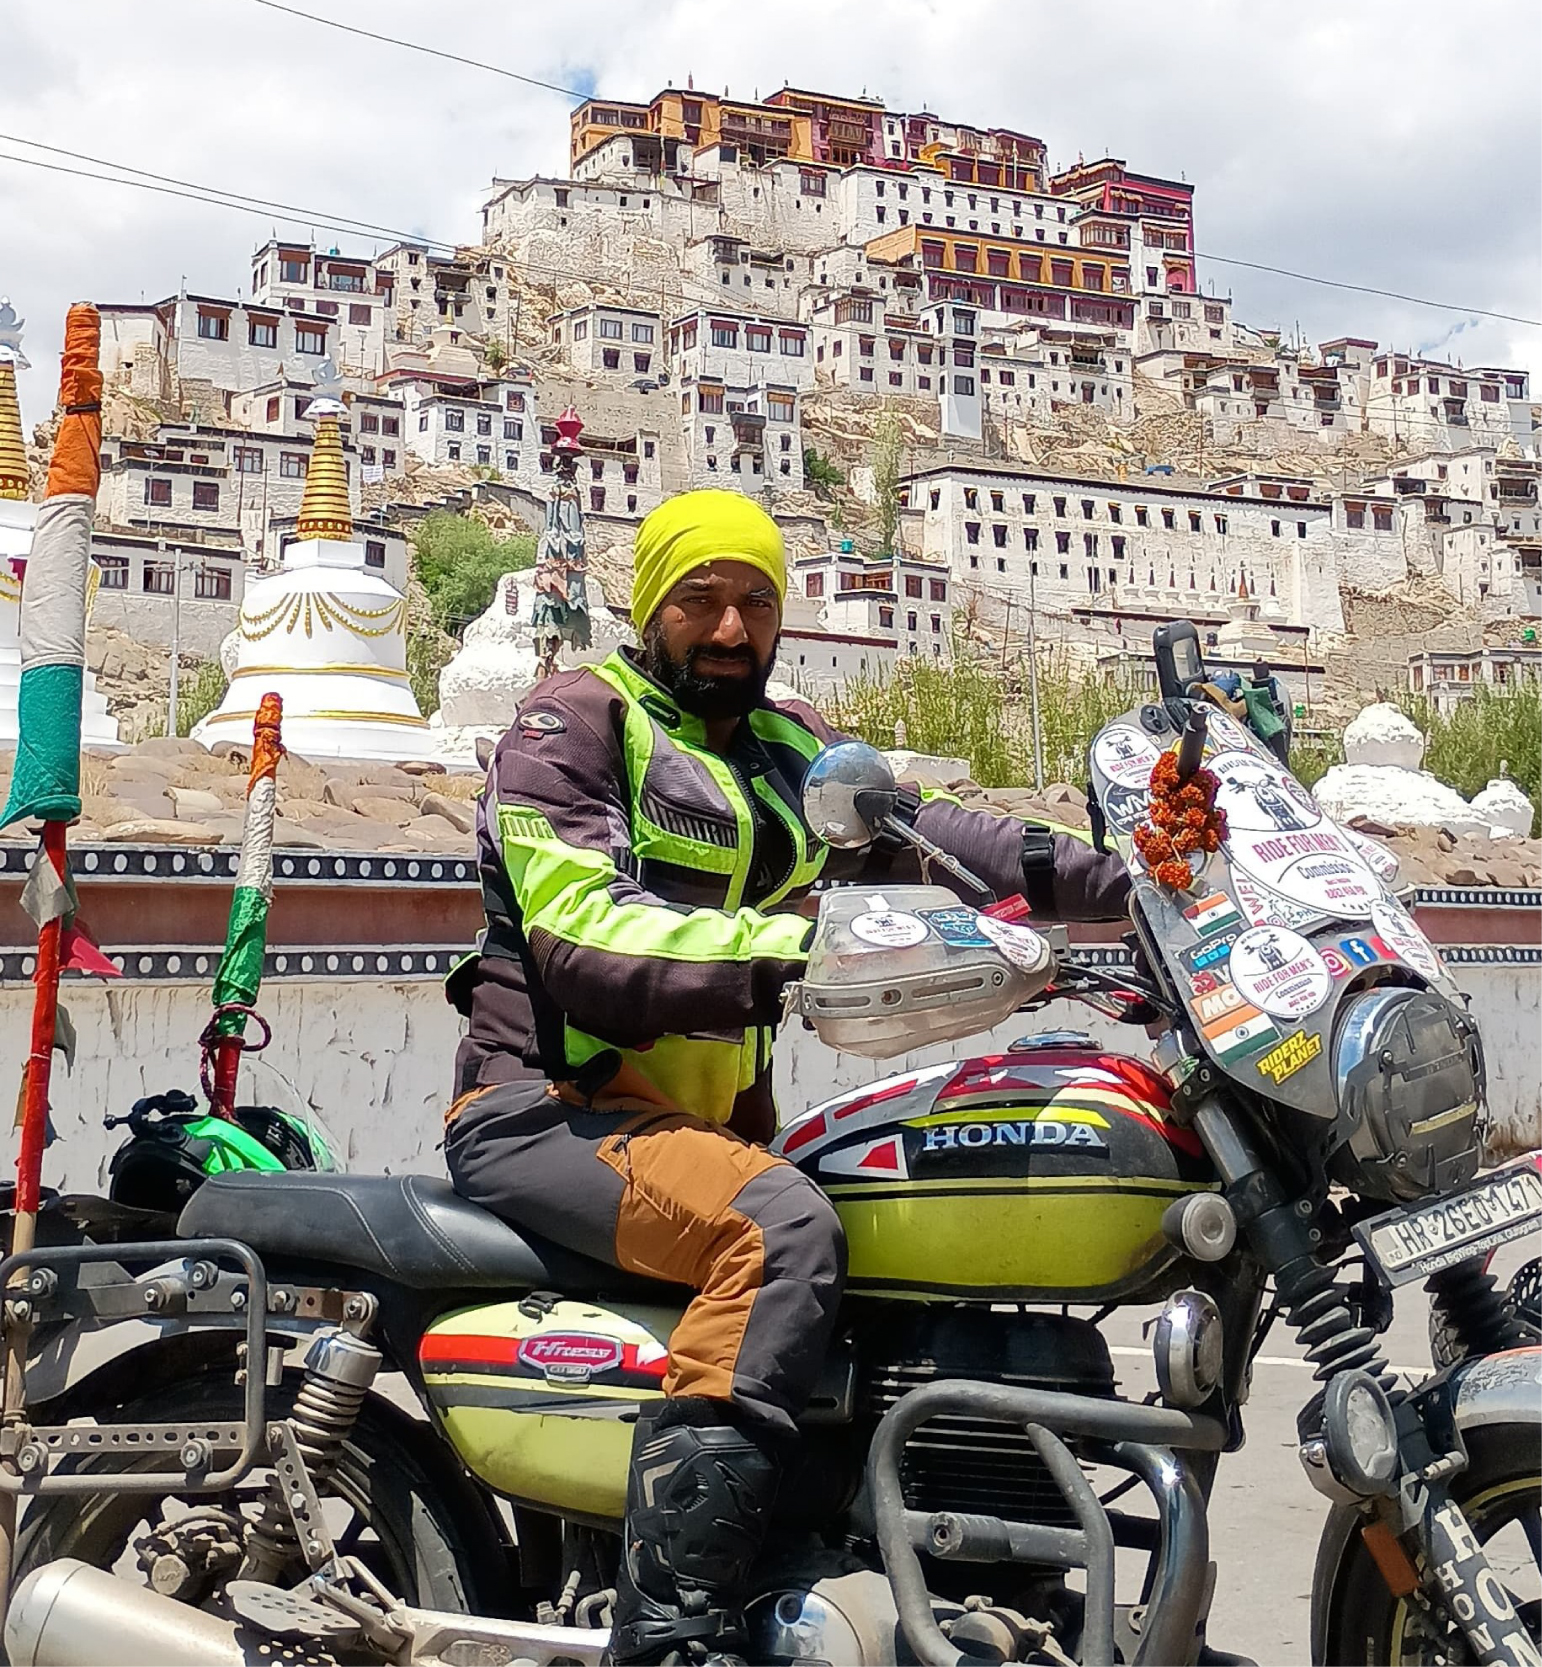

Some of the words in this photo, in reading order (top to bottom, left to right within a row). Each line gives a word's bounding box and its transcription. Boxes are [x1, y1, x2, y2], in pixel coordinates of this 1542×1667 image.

[1251, 837, 1288, 863] RIDE
[1288, 833, 1315, 856] FOR
[1190, 933, 1237, 960] GoPro
[1252, 975, 1274, 994] RIDE
[1273, 968, 1291, 986] FOR
[1289, 957, 1316, 977] MEN'S
[1257, 1030, 1308, 1076] RIDERZ
[1271, 1033, 1322, 1083] PLANET
[922, 1121, 1106, 1152] HONDA
